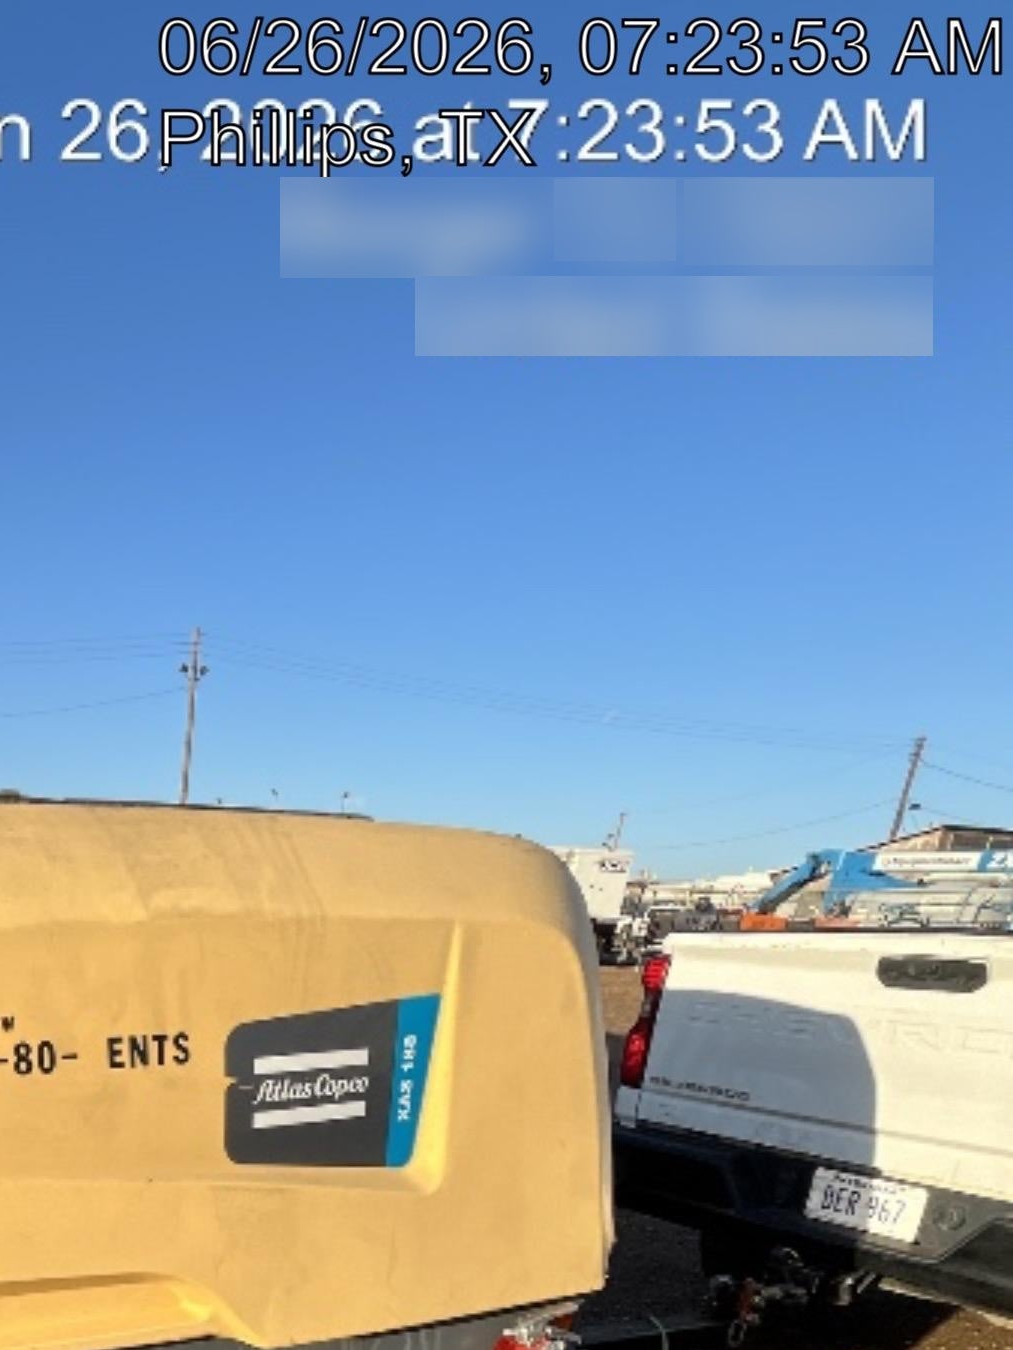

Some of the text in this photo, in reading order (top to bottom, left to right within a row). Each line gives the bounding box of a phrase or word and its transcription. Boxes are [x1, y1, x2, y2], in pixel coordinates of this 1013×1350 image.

[106, 1031, 192, 1070] ENTS
[252, 1073, 369, 1105] Atlas Copco
